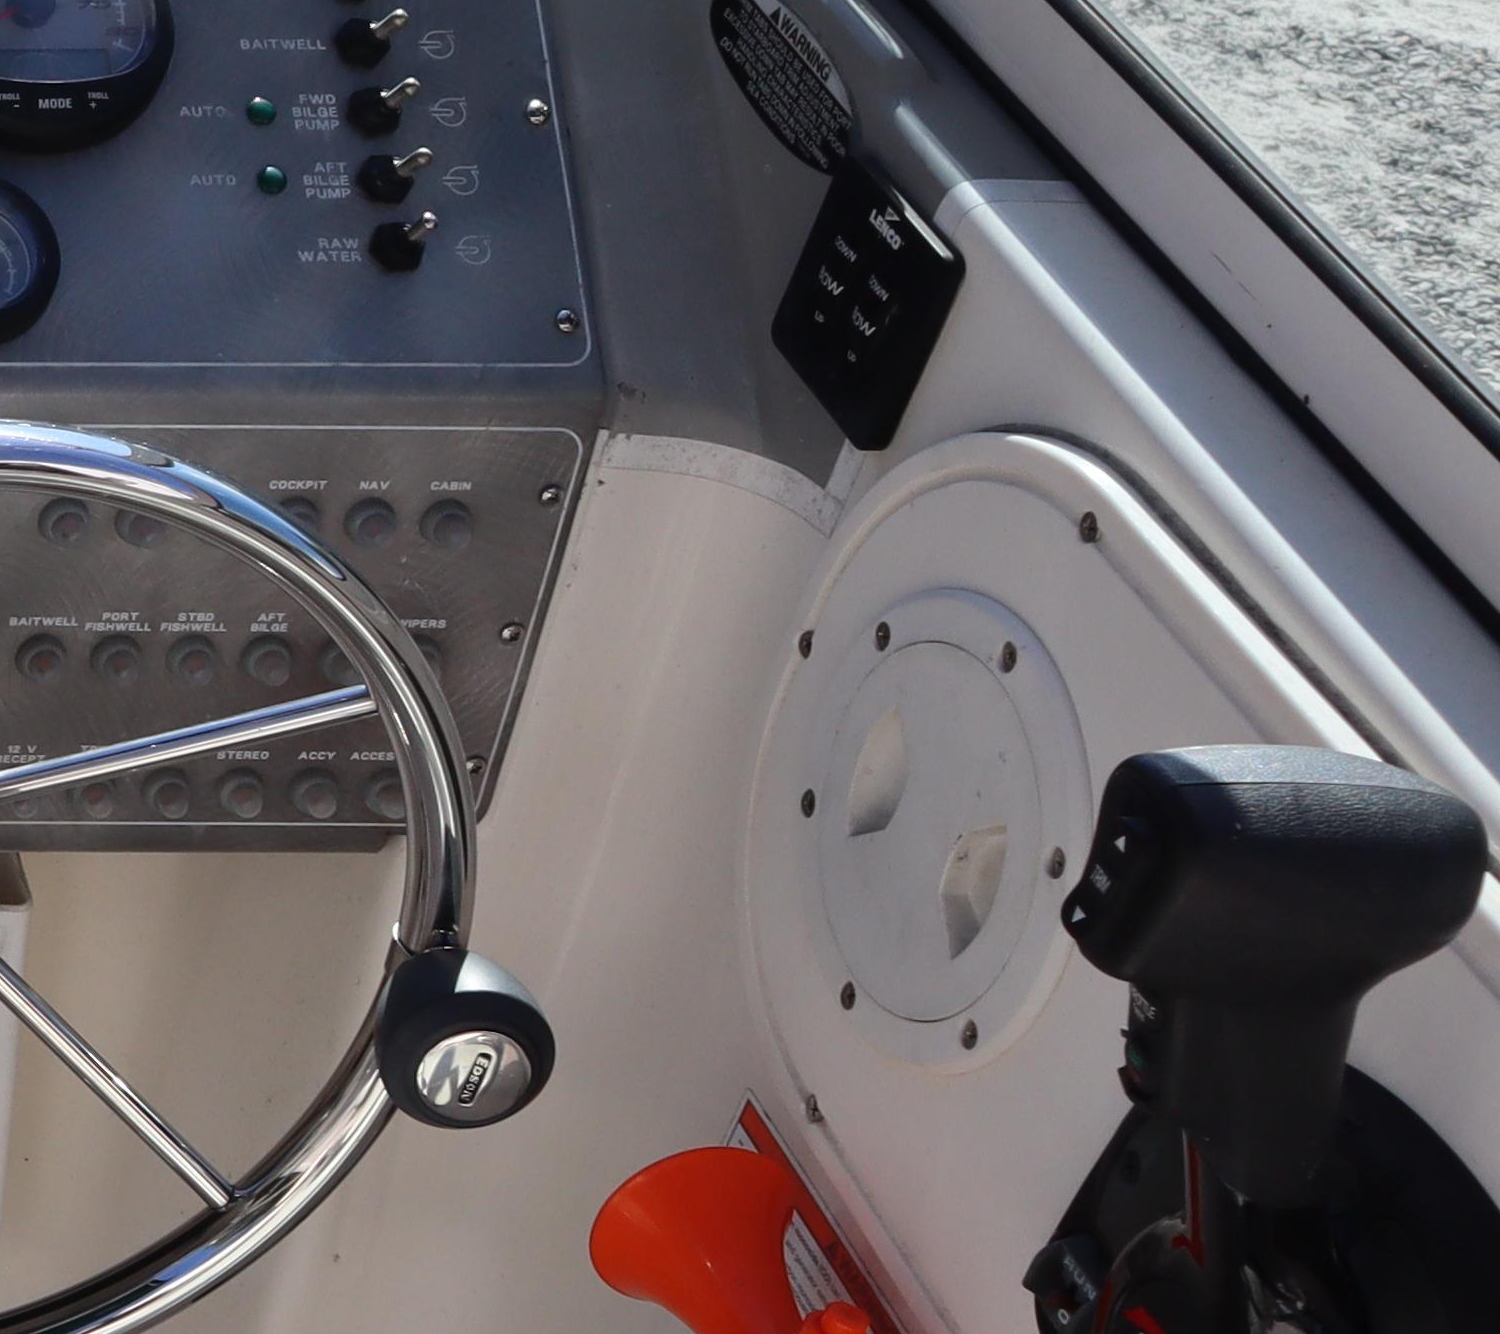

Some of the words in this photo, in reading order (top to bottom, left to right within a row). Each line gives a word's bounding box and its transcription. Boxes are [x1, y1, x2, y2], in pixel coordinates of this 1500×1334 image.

[240, 38, 328, 51] BAITWELL
[777, 12, 833, 85] WARNING
[38, 98, 73, 109] MODE
[299, 93, 336, 105] FWD
[179, 105, 227, 117] AUTO
[292, 106, 339, 118] BILGE
[294, 119, 340, 131] PUMP
[313, 162, 348, 173] AFT
[189, 174, 237, 186] AUTO
[303, 174, 350, 186] BILGE
[305, 188, 351, 200] PUMP
[869, 208, 902, 251] LENCO
[318, 238, 360, 249] RAW
[297, 250, 363, 263] WATER
[269, 480, 328, 491] COCKPIT
[359, 480, 391, 491] NAV
[430, 481, 473, 491] CABIN
[9, 616, 79, 627] BAITWELL
[102, 612, 140, 622] PORT
[177, 612, 215, 622] STBD
[257, 613, 286, 623] AFT
[84, 622, 152, 632] FISHWELL
[160, 622, 227, 633] FISHWELL
[250, 622, 288, 633] BILGE
[7, 744, 22, 754] 12
[216, 750, 270, 761] STEREO
[298, 751, 336, 761] ACCY
[461, 1055, 490, 1102] EDSON
